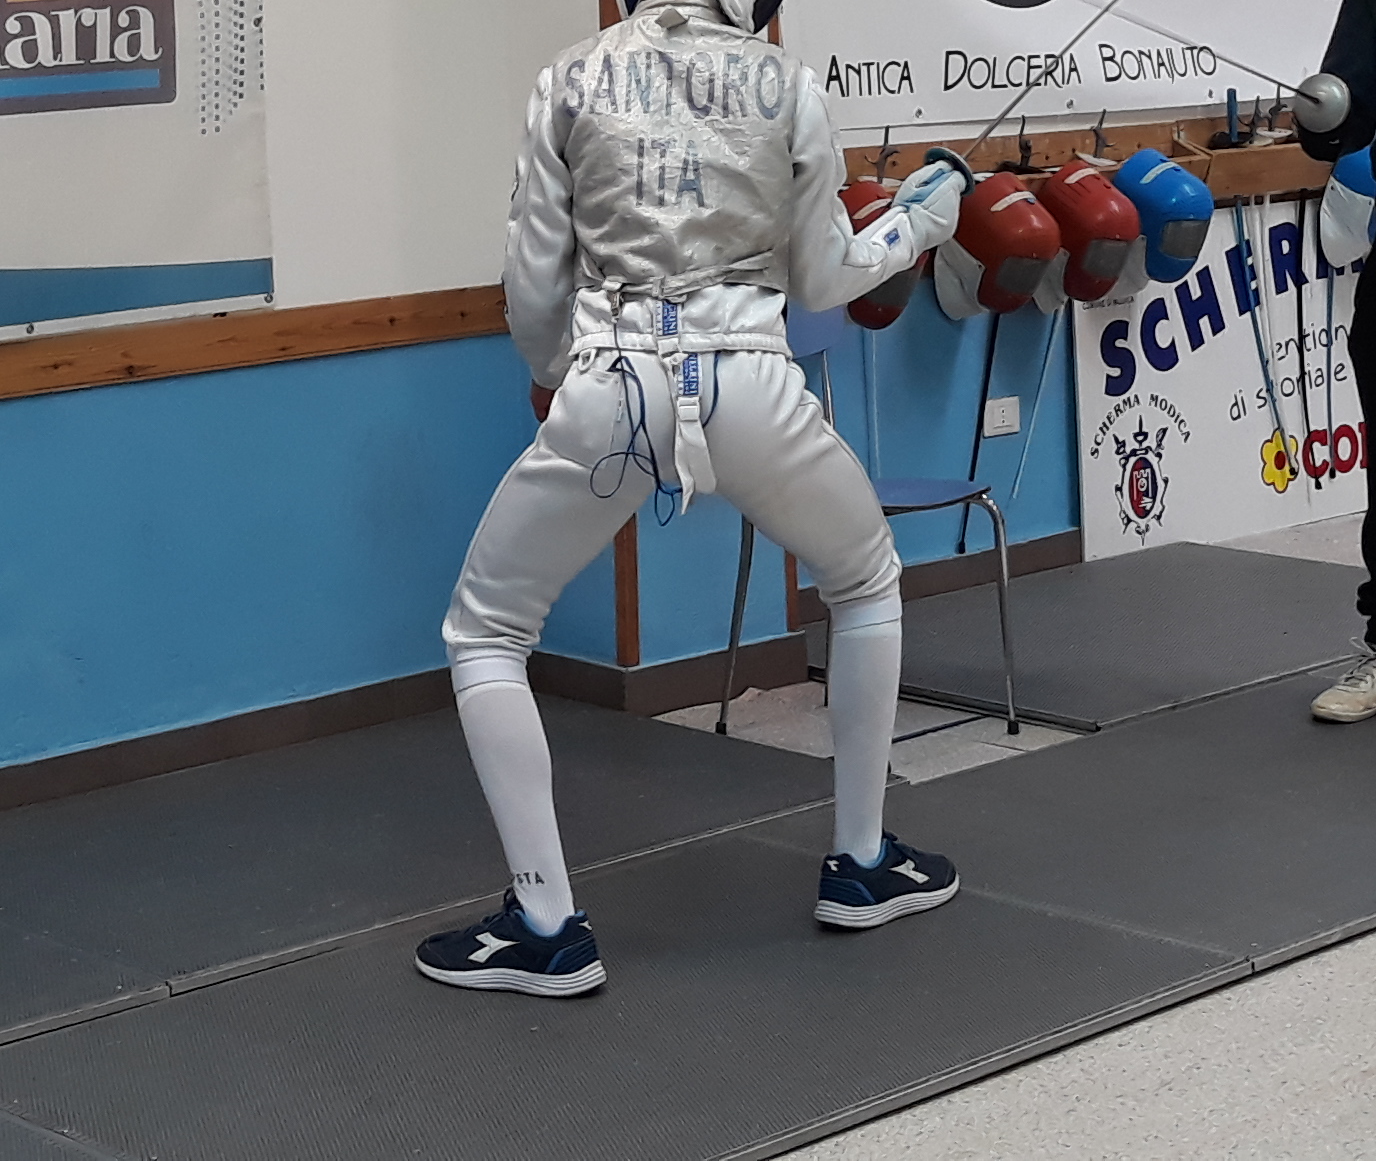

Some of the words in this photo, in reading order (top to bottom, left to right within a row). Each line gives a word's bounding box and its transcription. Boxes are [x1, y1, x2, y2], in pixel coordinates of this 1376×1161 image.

[562, 50, 787, 120] SANTORO
[825, 53, 914, 99] ANTICA
[942, 50, 1083, 91] DOLCERIA
[1099, 42, 1218, 86] BONAJUTO
[635, 137, 707, 209] ITA
[1229, 389, 1248, 421] di
[1256, 362, 1325, 410] soria
[1333, 362, 1348, 382] e
[1089, 393, 1141, 459] SCHERMA
[1147, 393, 1191, 443] MODICA
